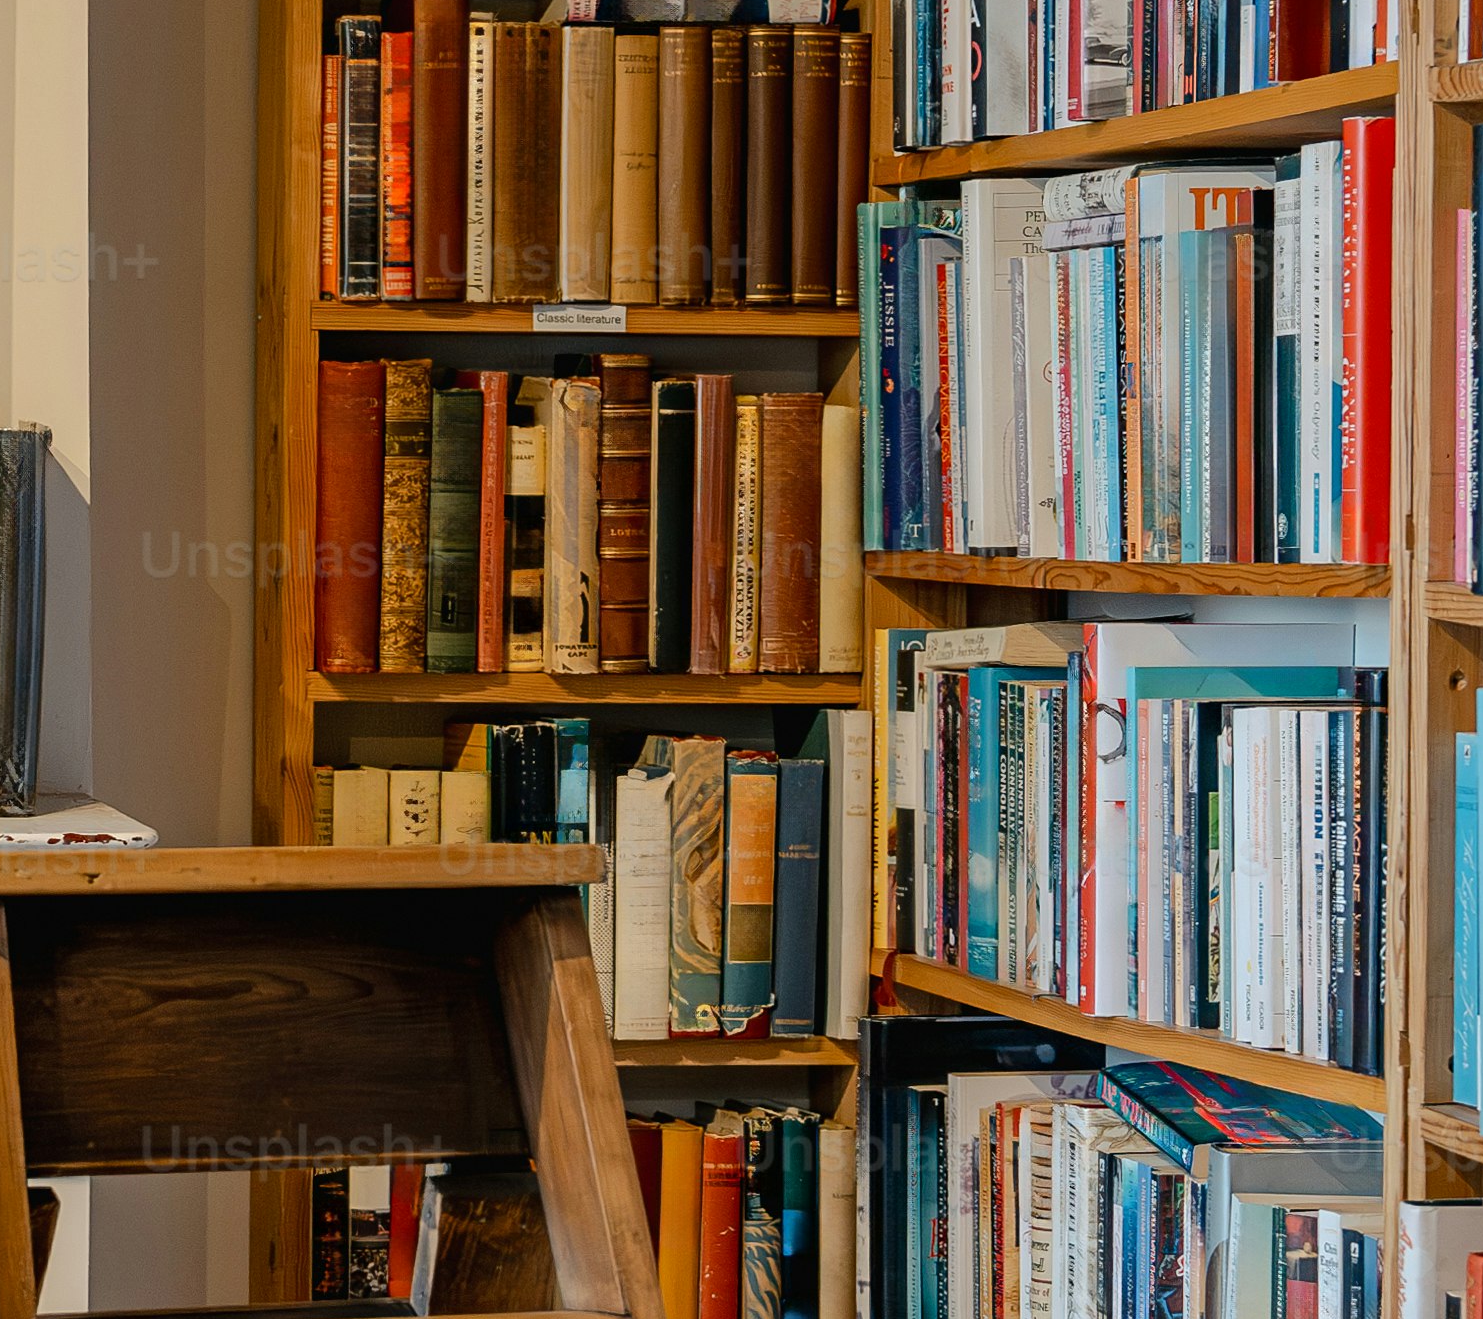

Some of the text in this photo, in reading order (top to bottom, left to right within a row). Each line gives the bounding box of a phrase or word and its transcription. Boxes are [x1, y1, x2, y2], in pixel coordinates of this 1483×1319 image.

[322, 123, 337, 265] WEE WILLIE WINKIE
[537, 313, 621, 324] Classic literature
[885, 282, 895, 348] JESSIE
[1458, 328, 1467, 508] THE NAKANO THRIFT SHOP
[735, 557, 745, 642] MACKENZIE
[746, 567, 755, 631] COMPTON
